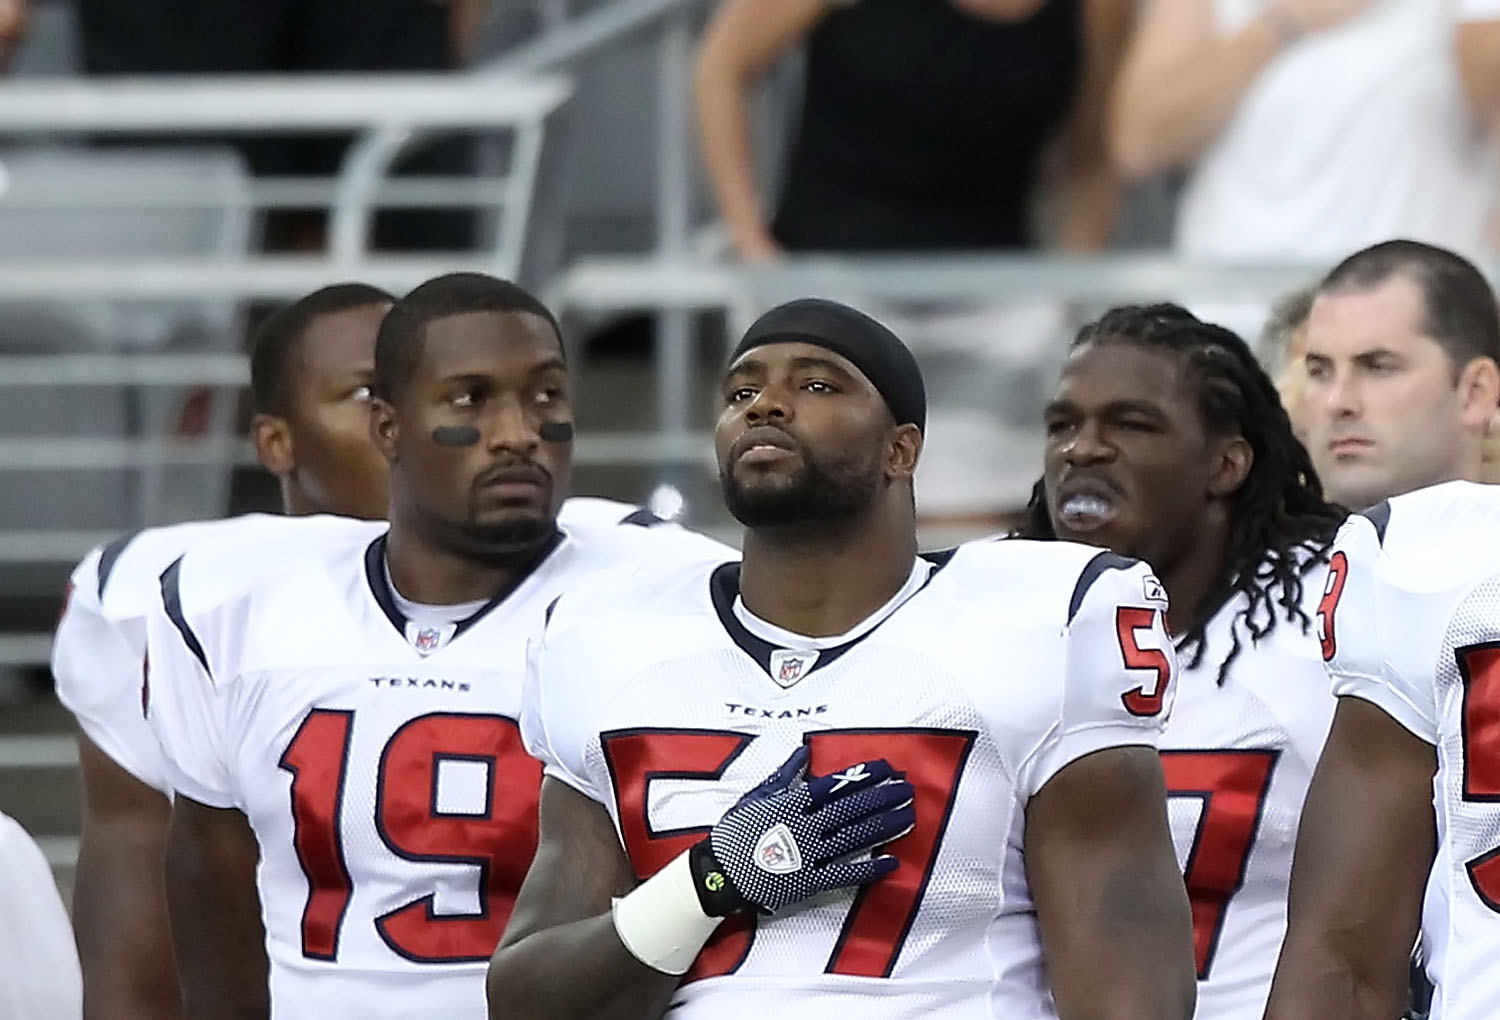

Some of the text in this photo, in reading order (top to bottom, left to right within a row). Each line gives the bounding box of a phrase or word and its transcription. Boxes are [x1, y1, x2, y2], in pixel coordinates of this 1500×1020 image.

[369, 677, 471, 692] TEXANS
[725, 702, 828, 719] TEXANS
[1116, 606, 1172, 716] 5
[278, 707, 543, 963] 19
[601, 727, 979, 980] 57
